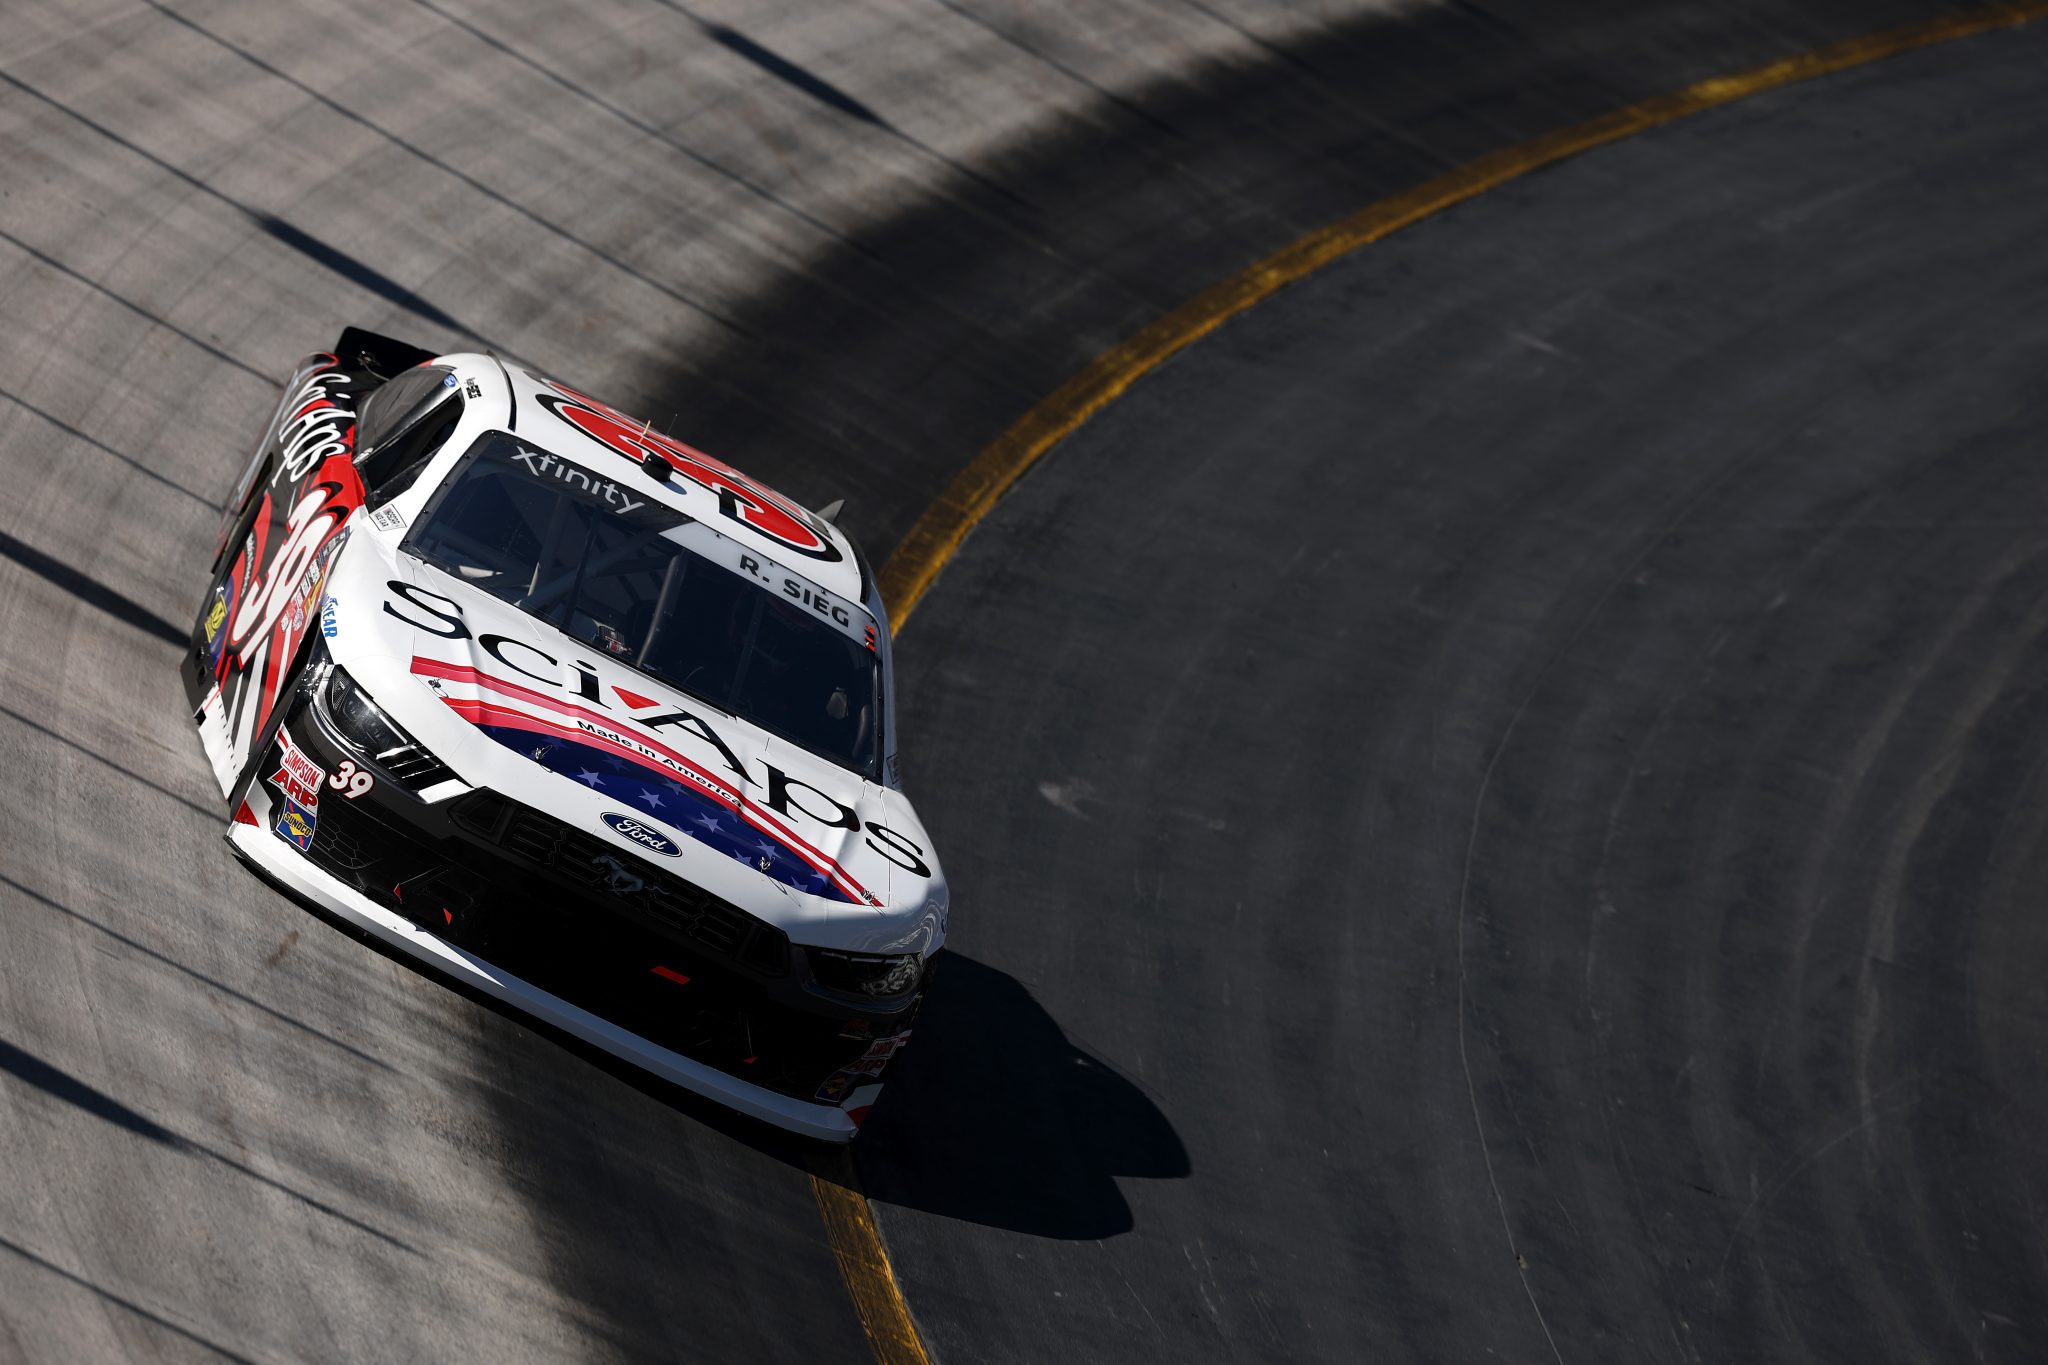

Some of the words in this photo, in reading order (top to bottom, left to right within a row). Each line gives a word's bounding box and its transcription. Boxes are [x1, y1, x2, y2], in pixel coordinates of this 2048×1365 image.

[510, 446, 645, 514] xfinity
[740, 554, 770, 583] R.
[783, 578, 849, 628] SIEG
[384, 580, 932, 878] SciAps
[284, 749, 321, 787] SIMPSON
[328, 759, 375, 800] 39
[577, 720, 632, 748] Made
[638, 744, 656, 759] in
[662, 758, 743, 808] America
[272, 768, 319, 808] ARP
[284, 812, 312, 837] SUNOCO
[616, 818, 669, 850] Ford
